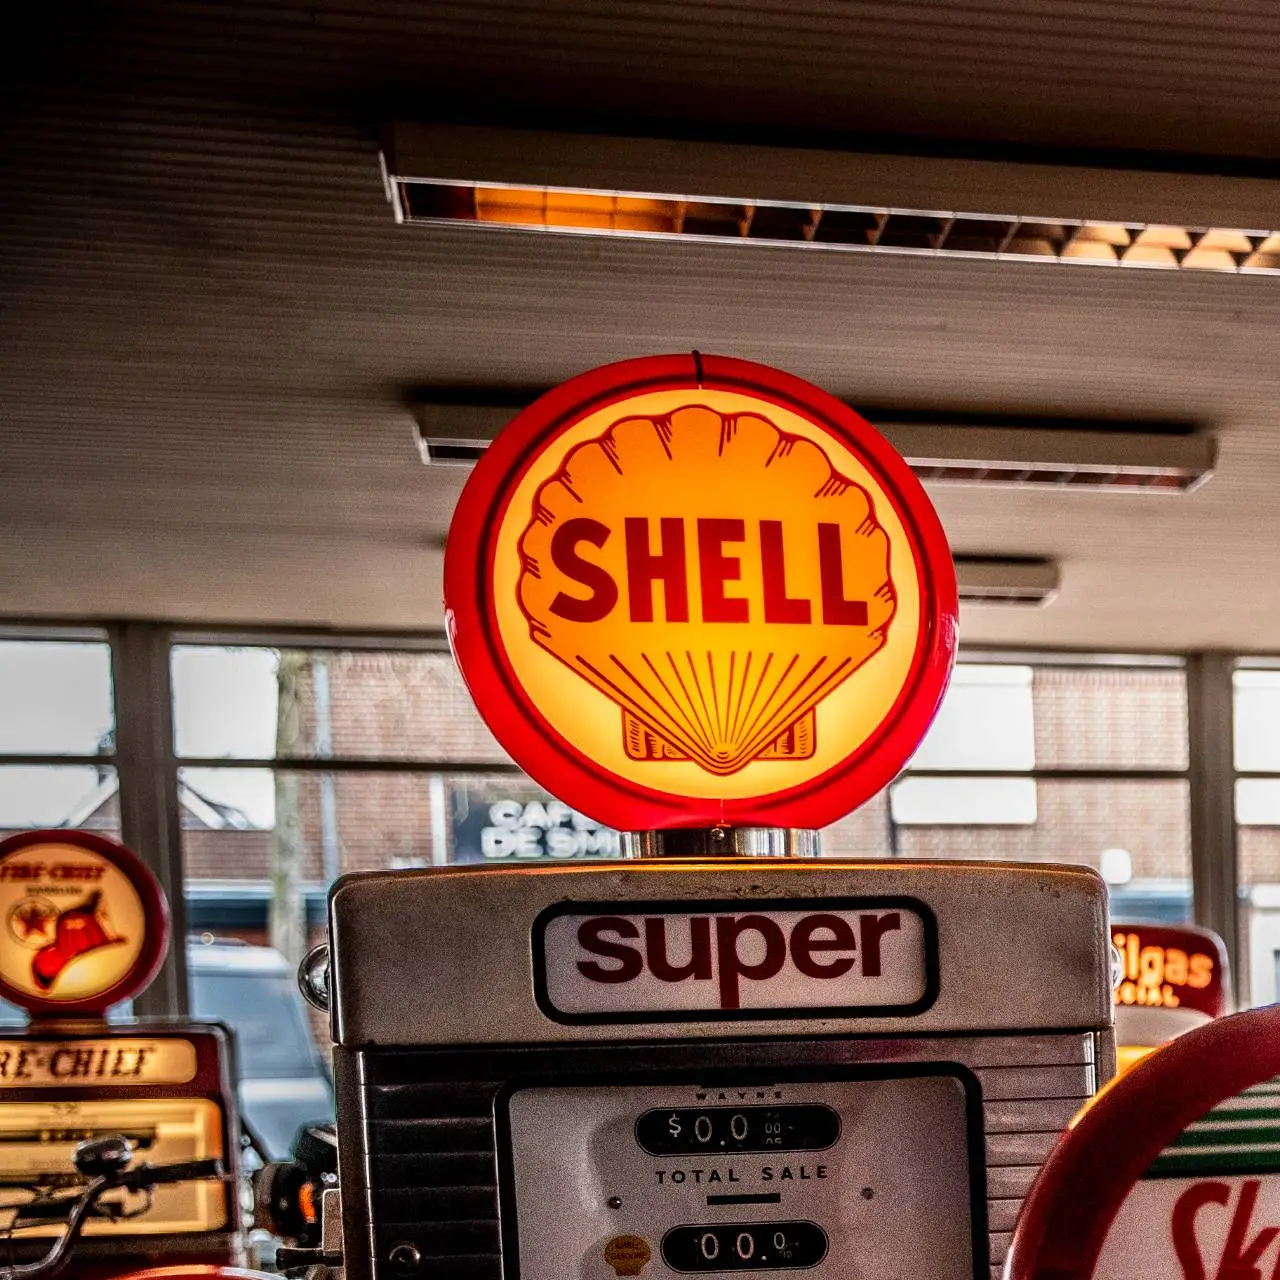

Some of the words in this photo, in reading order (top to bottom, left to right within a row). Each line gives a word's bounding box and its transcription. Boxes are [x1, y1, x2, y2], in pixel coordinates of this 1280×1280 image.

[549, 517, 868, 625] SHELL
[577, 911, 899, 1010] super
[696, 1091, 782, 1100] WAYNE
[655, 1169, 739, 1184] TOTAL
[762, 1166, 827, 1181] SALE
